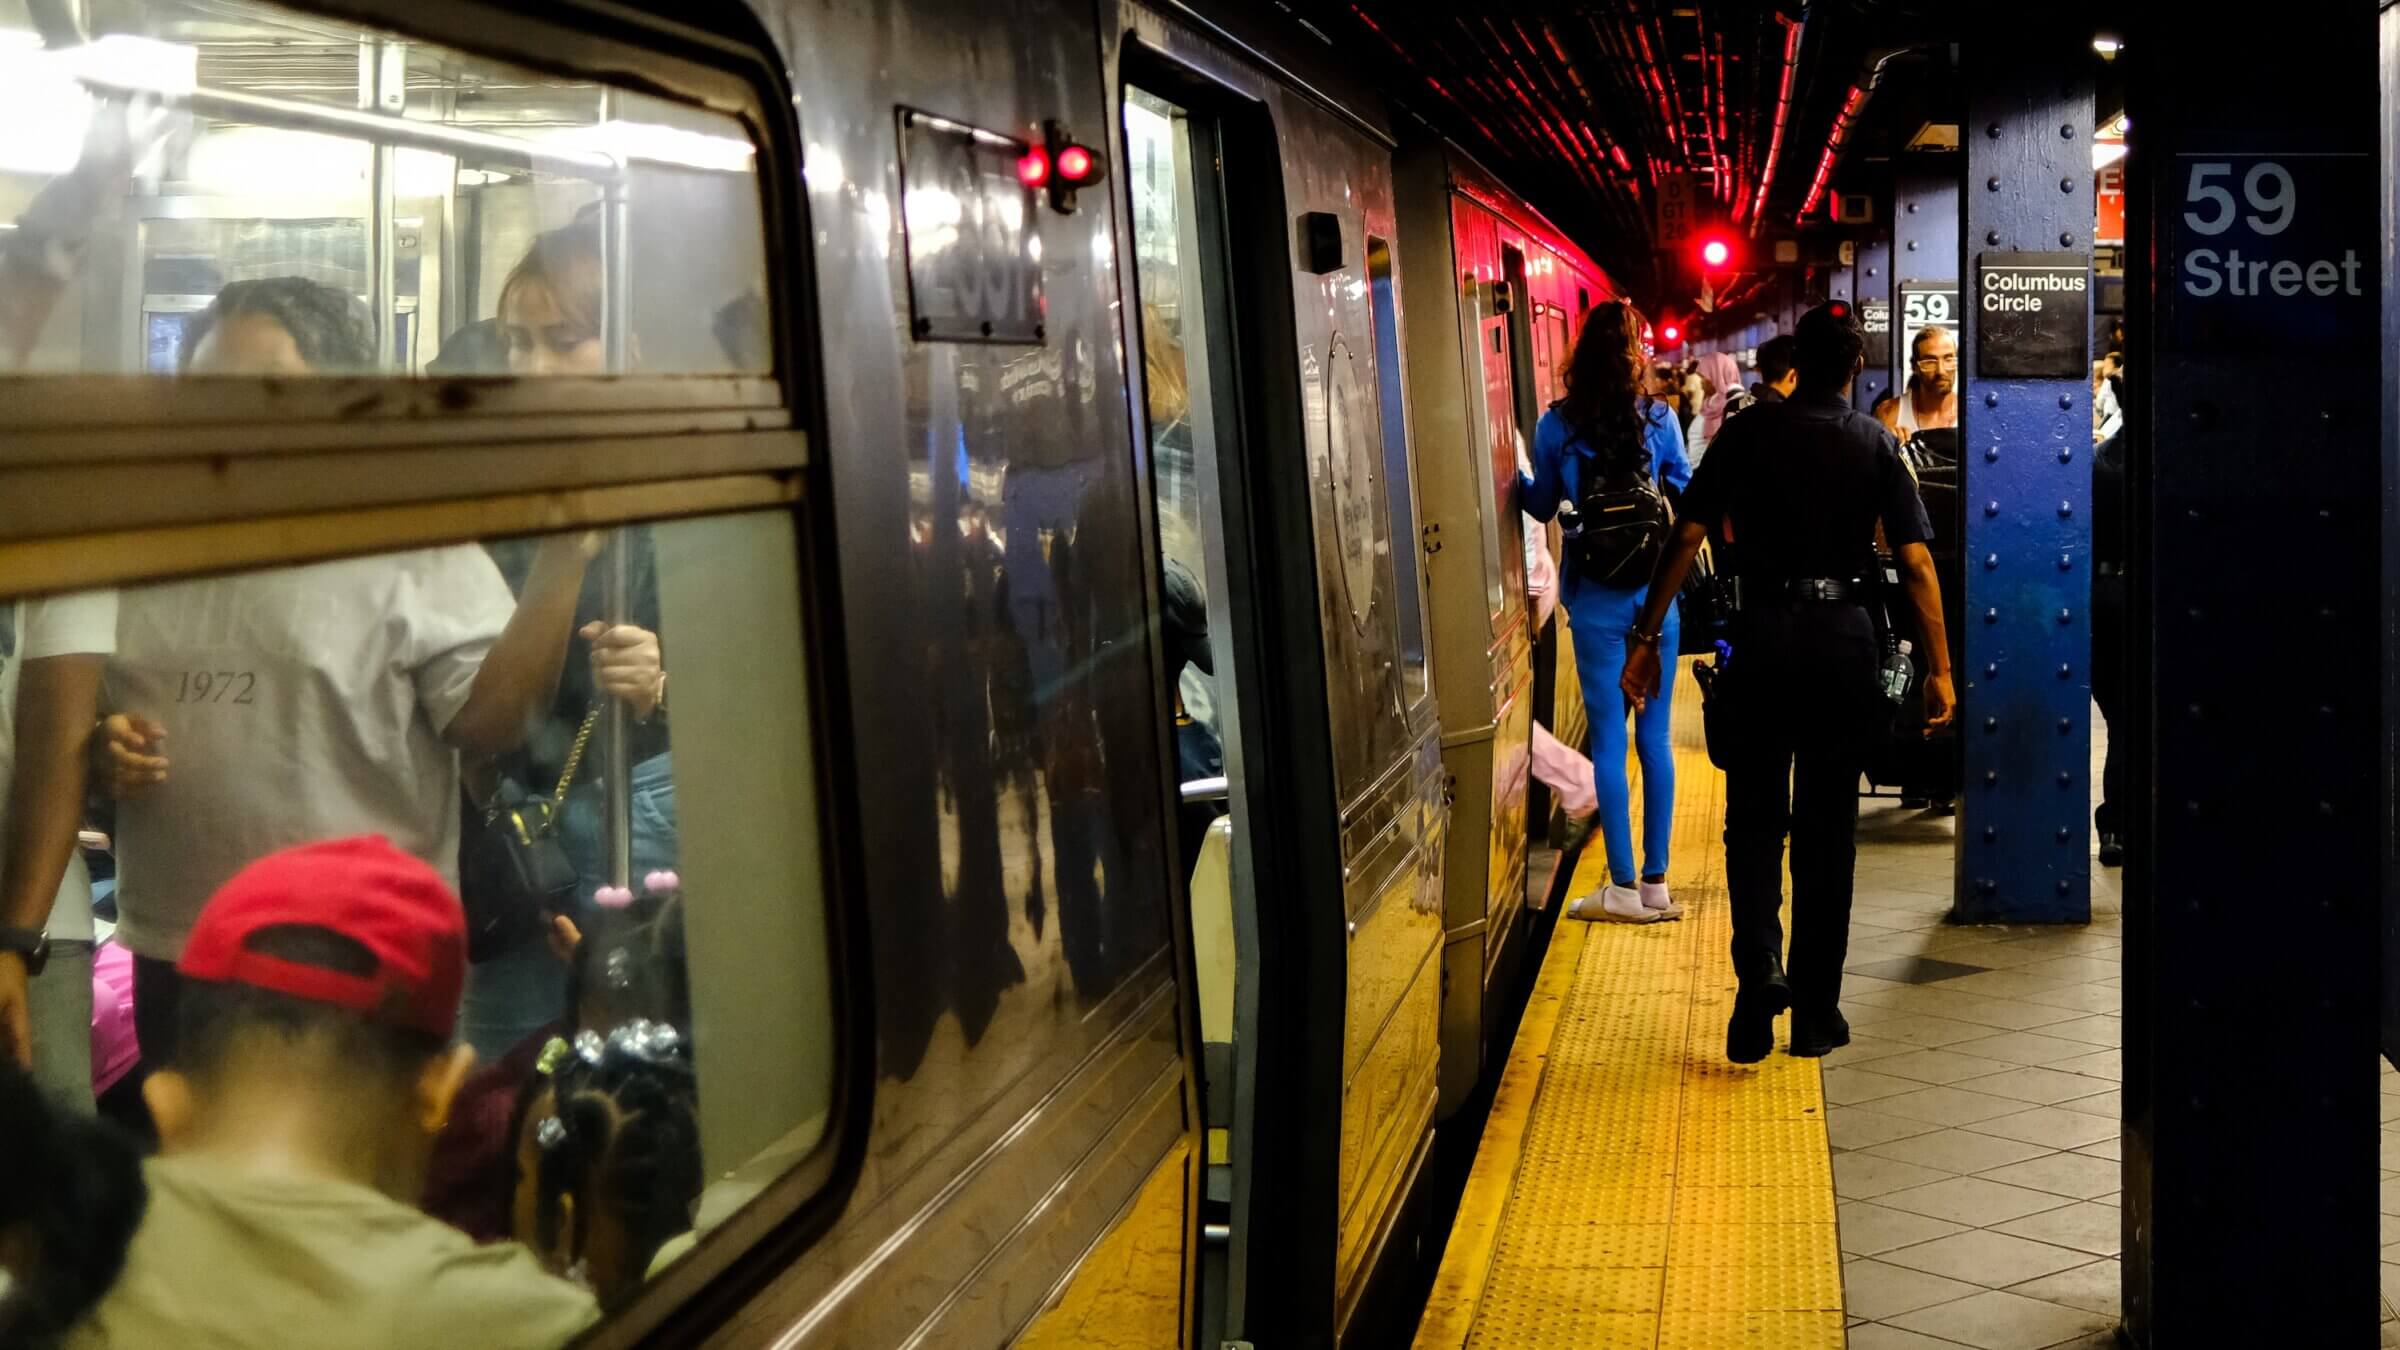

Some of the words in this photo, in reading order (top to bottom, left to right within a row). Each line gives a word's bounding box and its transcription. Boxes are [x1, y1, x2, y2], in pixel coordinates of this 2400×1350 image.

[2183, 161, 2296, 236] 59
[1983, 272, 2086, 292] Columbus
[2183, 248, 2362, 297] Street
[1904, 294, 1949, 320] 59
[1983, 293, 2042, 312] Circle
[176, 670, 256, 705] 1972
